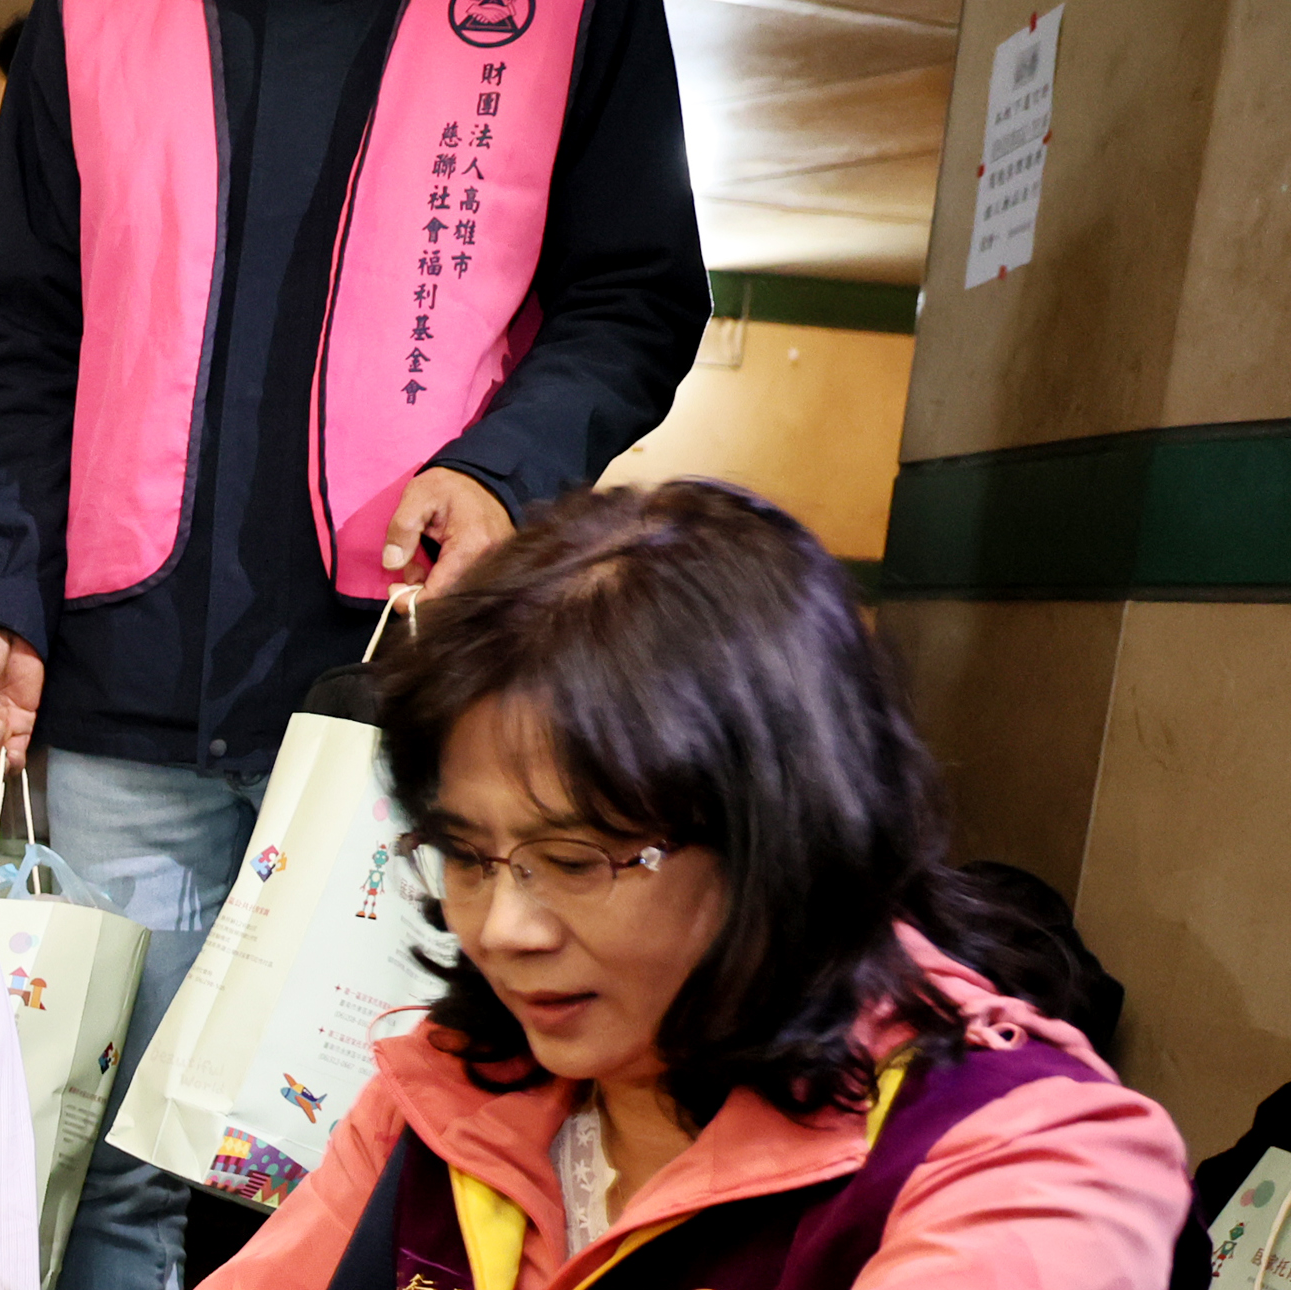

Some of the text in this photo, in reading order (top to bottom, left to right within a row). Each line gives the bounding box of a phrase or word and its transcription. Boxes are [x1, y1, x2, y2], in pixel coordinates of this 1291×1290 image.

[400, 121, 463, 405] 慈聯社會福利基金會
[451, 62, 507, 280] 財團法人高雄市
